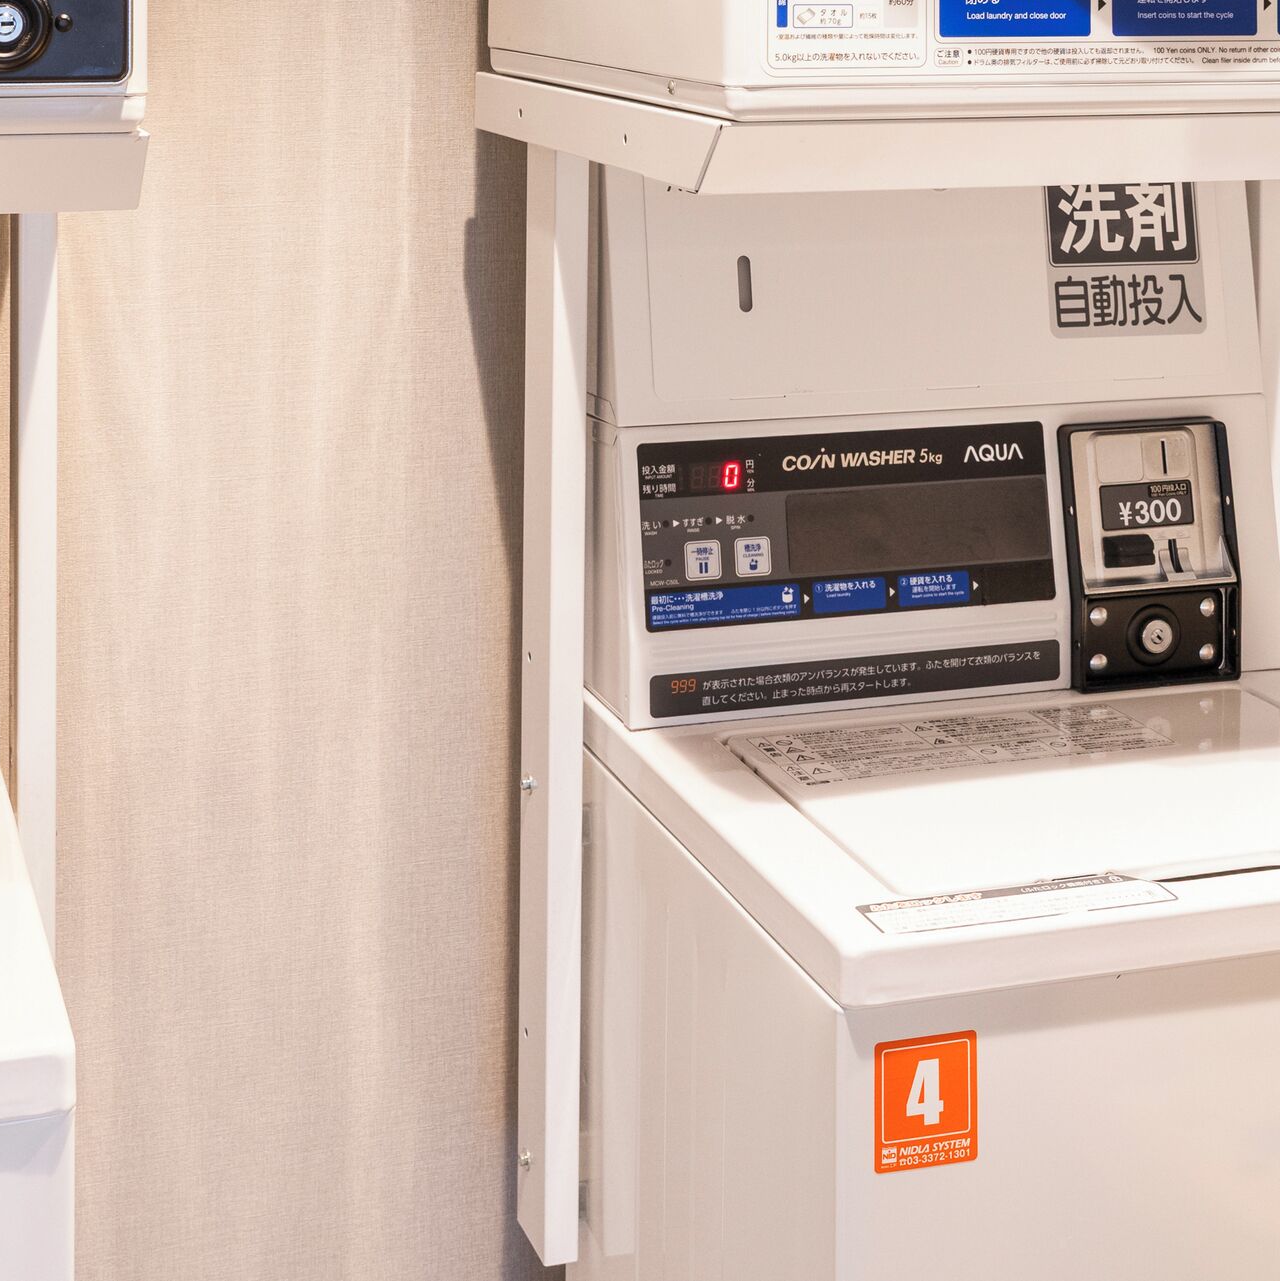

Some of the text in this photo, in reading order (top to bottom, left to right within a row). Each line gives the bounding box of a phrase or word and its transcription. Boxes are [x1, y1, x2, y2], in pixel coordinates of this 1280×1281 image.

[1057, 182, 1188, 254] 洗剤
[1054, 273, 1203, 328] 自動投入
[840, 448, 915, 468] WASHER
[963, 442, 1024, 464] AQUA
[724, 464, 739, 488] 0
[1118, 497, 1182, 527] ¥300
[651, 603, 695, 613] Pre-Cleaning
[670, 678, 697, 696] 999
[906, 1057, 945, 1126] 4
[899, 1137, 971, 1157] NIDLA SYSTEM
